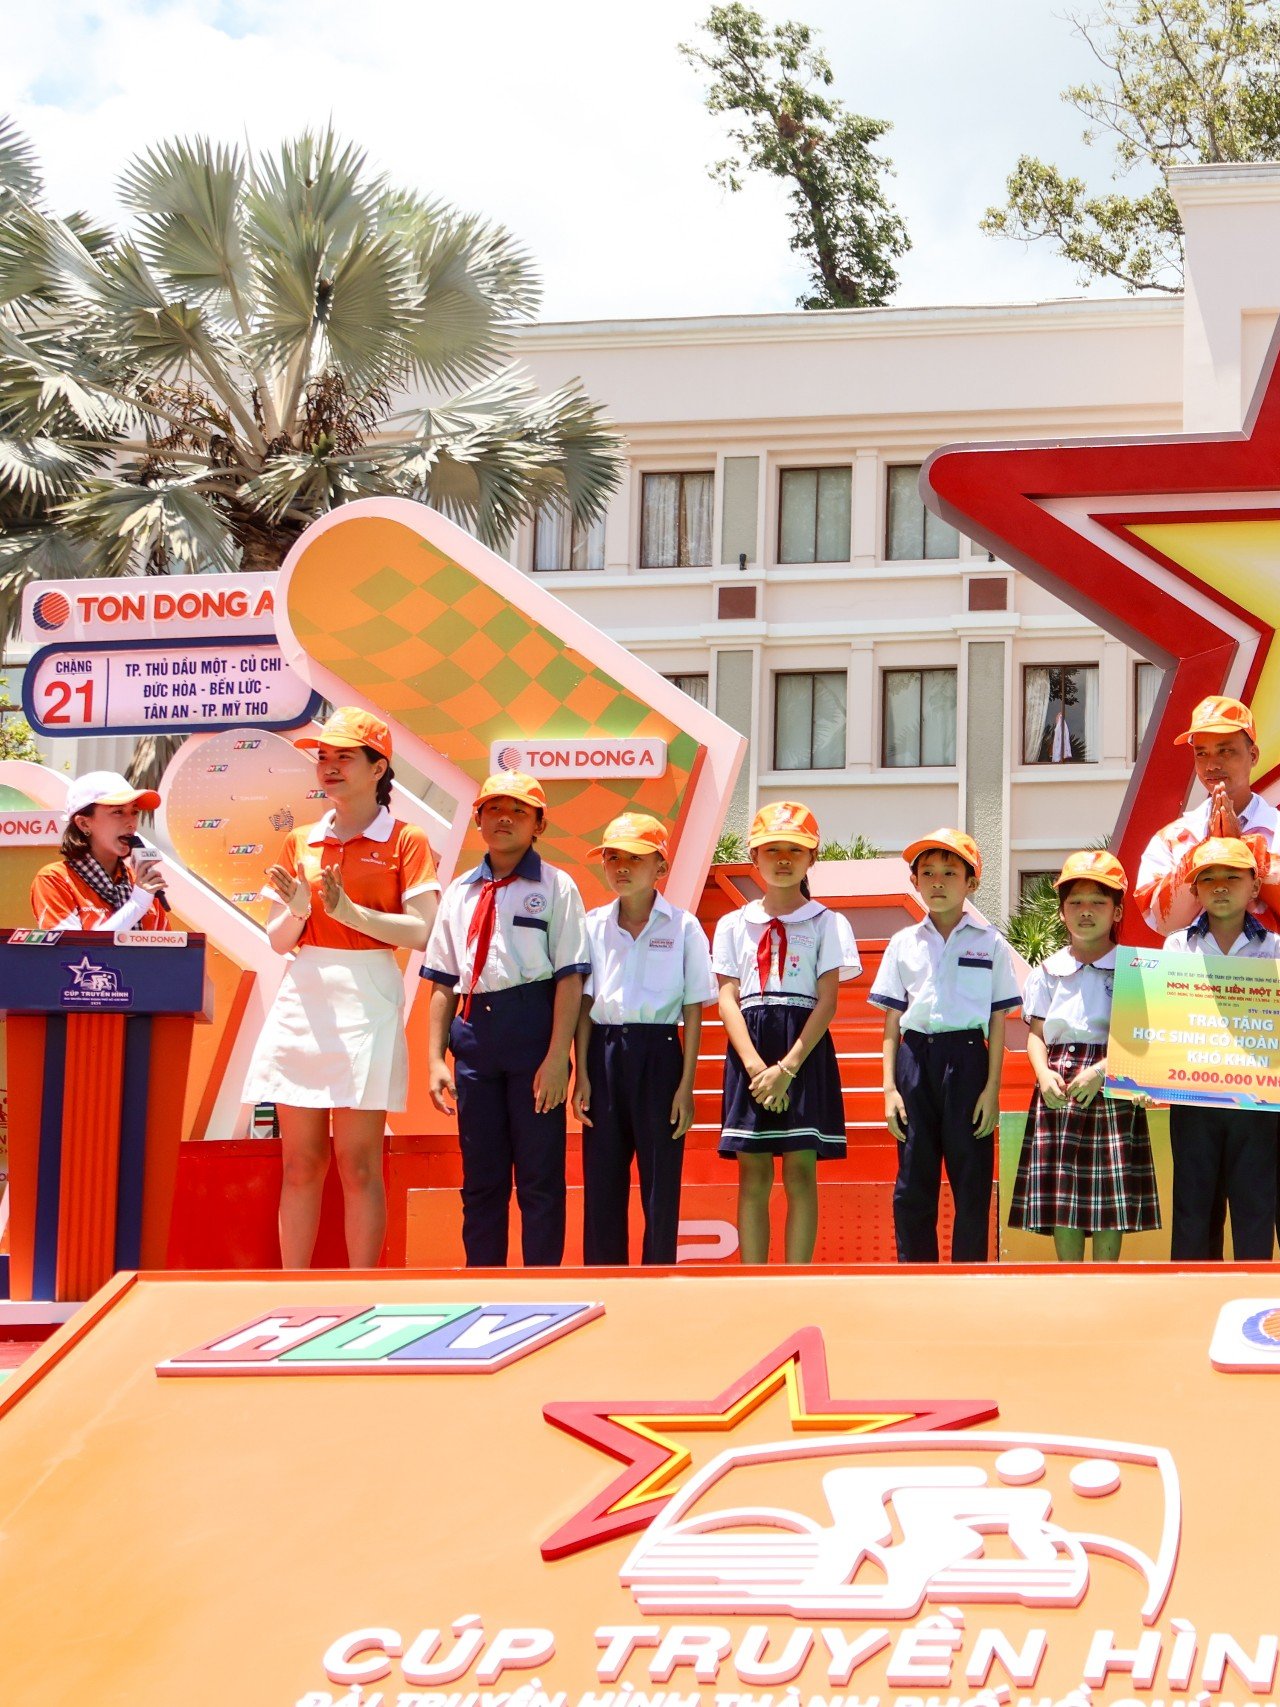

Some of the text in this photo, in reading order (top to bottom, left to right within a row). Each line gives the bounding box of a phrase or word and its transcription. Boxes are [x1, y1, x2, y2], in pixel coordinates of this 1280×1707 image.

[77, 595, 145, 624] TON
[153, 590, 248, 621] DONG
[55, 658, 93, 676] CHẶNG
[125, 663, 142, 677] TP.
[145, 658, 168, 676] THỦ
[172, 656, 197, 675] DẦU
[201, 658, 227, 676] MỘT
[240, 655, 256, 673] CỦ
[260, 657, 281, 672] CHI
[143, 680, 168, 698] ĐỨC
[172, 679, 197, 697] HÒA
[209, 676, 234, 695] BẾN
[239, 677, 261, 695] LỨC
[42, 679, 94, 725] 21
[144, 702, 167, 720] TÂN
[171, 704, 189, 719] AN
[201, 703, 217, 718] TP.
[221, 700, 241, 717] MỸ
[245, 701, 268, 716] THO
[526, 749, 654, 767] TON DONG A
[45, 819, 58, 834] A
[11, 930, 184, 944] HTV TON DONG A
[1167, 981, 1189, 990] NON
[1187, 1013, 1274, 1033] TRAO TẶNG
[1132, 1027, 1166, 1043] HỌC
[1170, 1030, 1206, 1045] SINH
[1210, 1032, 1231, 1047] CÓ
[1235, 1035, 1279, 1050] HOÀN
[1187, 1050, 1270, 1068] KHÓ KHĂN
[1167, 1068, 1252, 1085] 20.000.000
[200, 1312, 562, 1352] HTV
[323, 1613, 556, 1686] CÚP
[594, 1607, 1047, 1688] TRUYỀN
